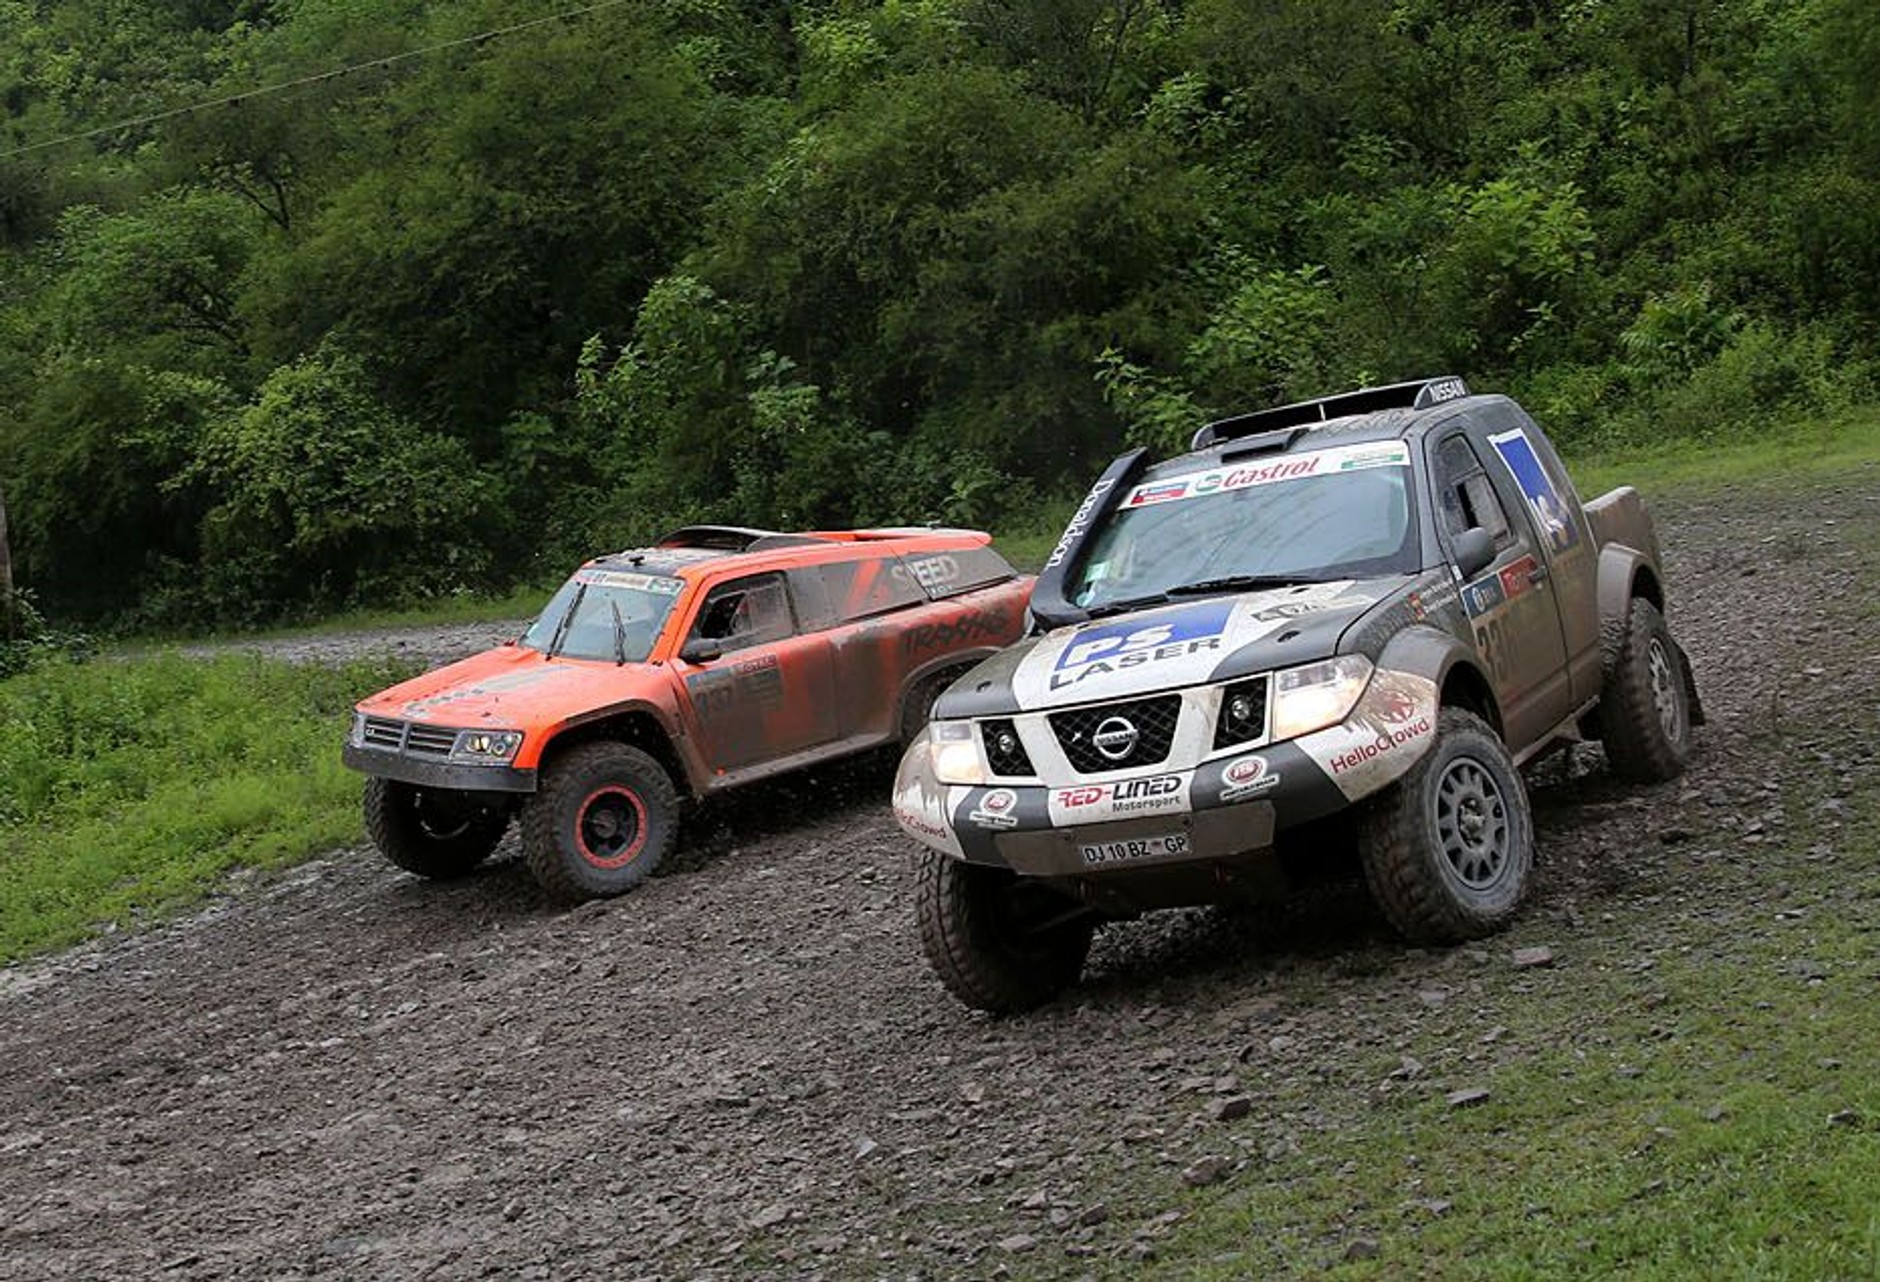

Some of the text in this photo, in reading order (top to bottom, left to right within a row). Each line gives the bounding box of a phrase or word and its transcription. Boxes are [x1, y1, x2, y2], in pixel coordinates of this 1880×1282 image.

[1430, 380, 1465, 402] NISSAN
[1223, 457, 1320, 487] Castrol
[1043, 478, 1116, 571] Donaldson
[1064, 623, 1176, 667] PS
[1050, 637, 1221, 691] LASER
[1096, 731, 1134, 745] NISSAN
[1330, 718, 1430, 774] HelloCrowd
[1058, 775, 1182, 807] RED-LINED
[1112, 795, 1181, 812] Motorsport
[1084, 836, 1187, 862] DJ 10 BZ GP
